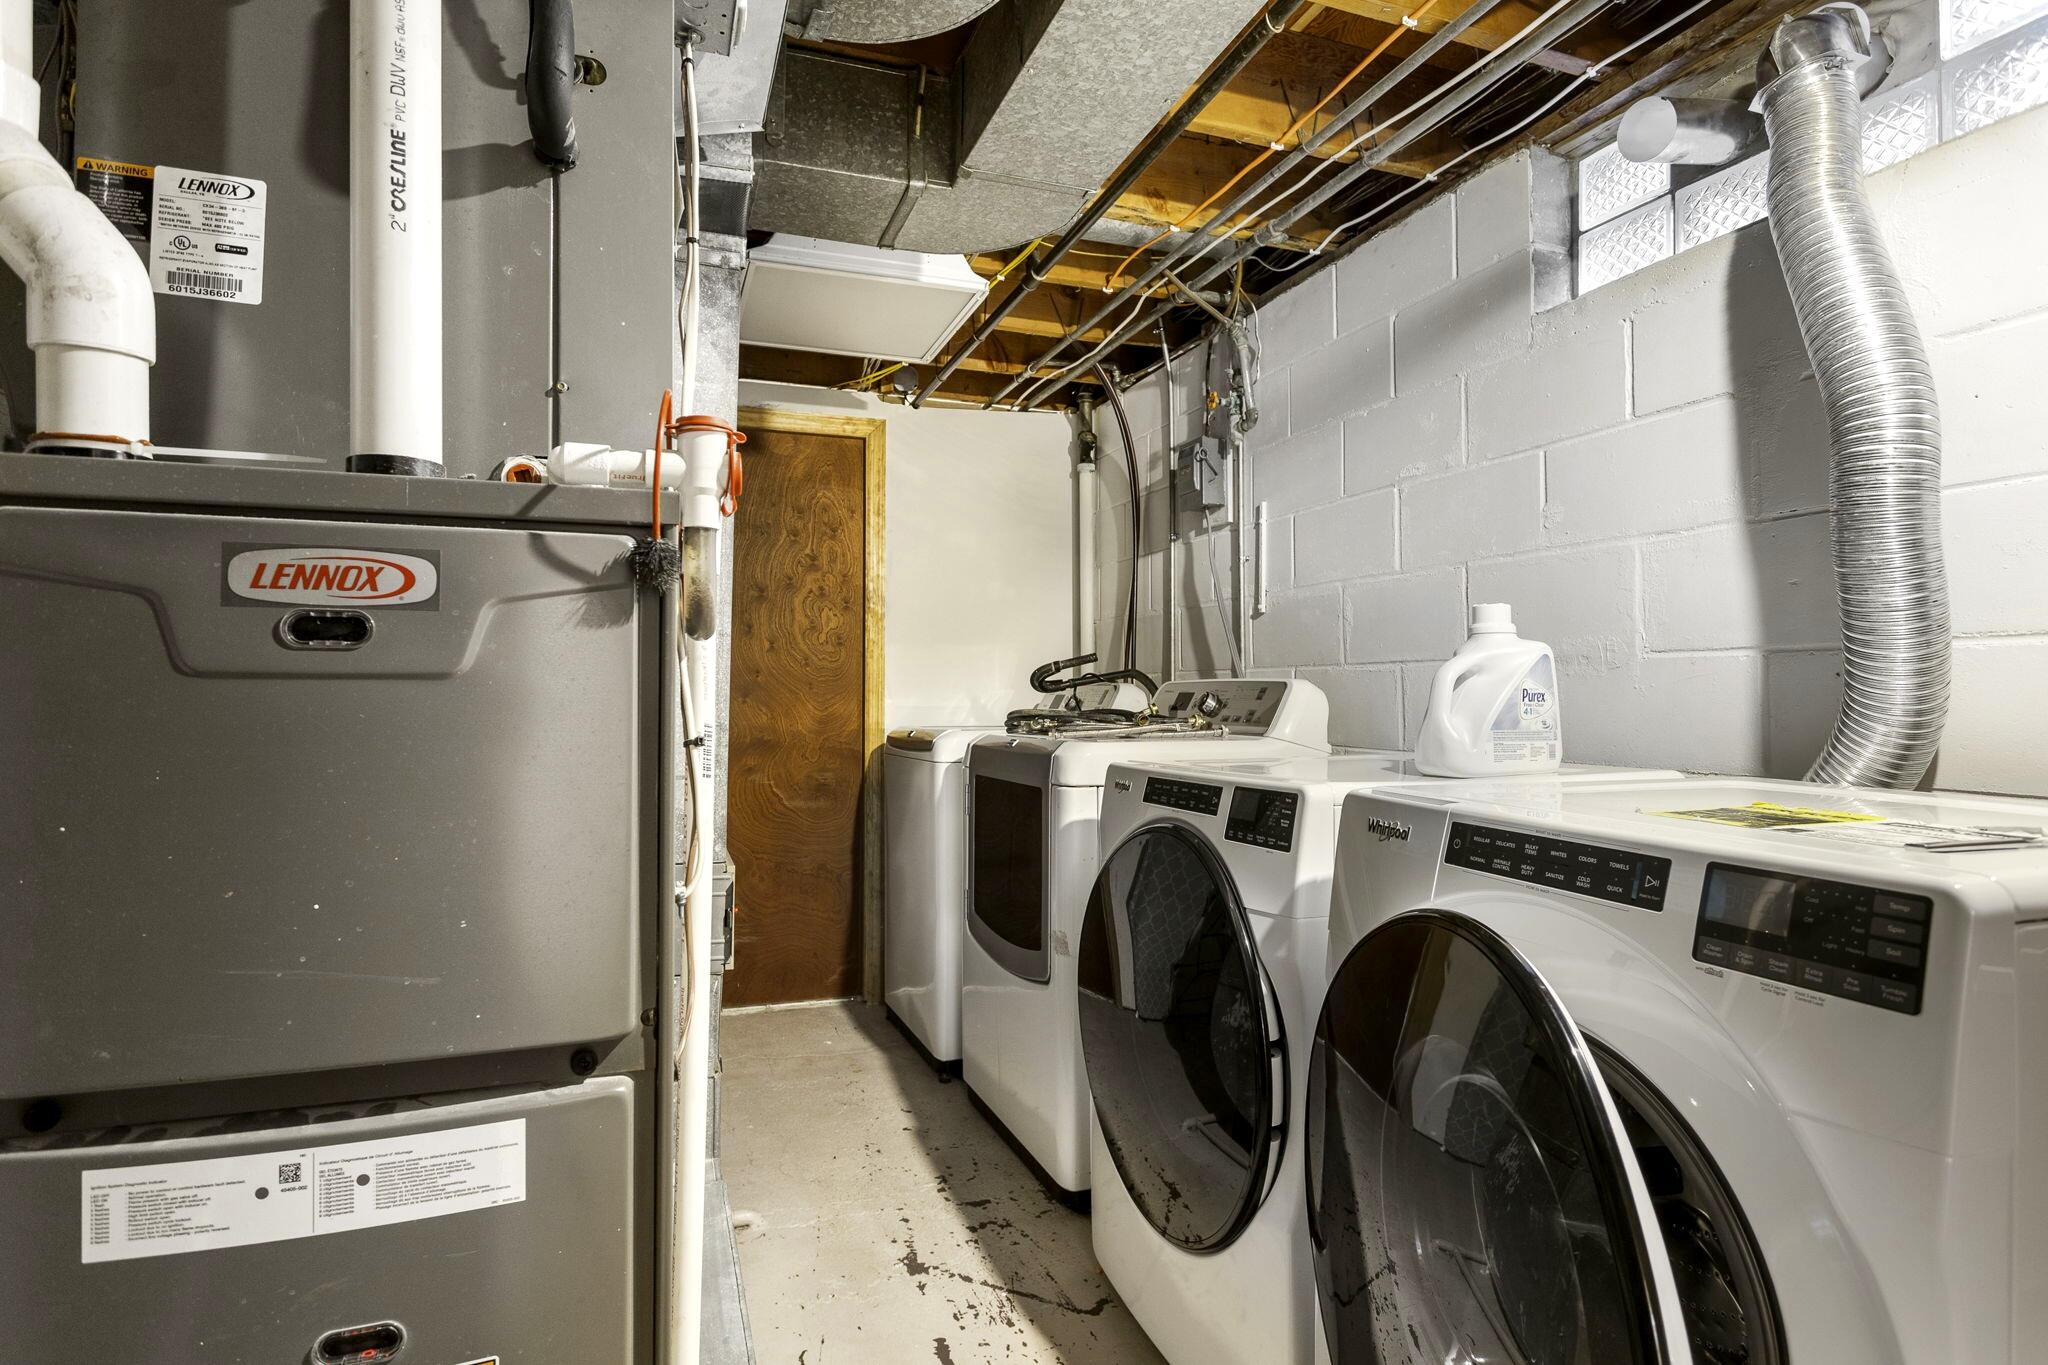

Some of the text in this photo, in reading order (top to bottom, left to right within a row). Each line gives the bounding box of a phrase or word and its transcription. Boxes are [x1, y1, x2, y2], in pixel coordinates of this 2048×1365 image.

[394, 40, 406, 62] NSF
[395, 100, 406, 122] PVC
[96, 162, 148, 176] WARNING
[390, 128, 406, 212] CRESLINE
[178, 178, 240, 196] LENNOX
[204, 269, 234, 278] NUMBER
[169, 285, 236, 299] 6015J36602
[249, 562, 385, 592] LENNOX
[1522, 688, 1545, 702] Purex
[1368, 817, 1412, 841] Whirlpool
[1496, 840, 1516, 848] DELICATES
[1578, 855, 1597, 864] COLORS
[1609, 862, 1629, 870] TOWELS
[1492, 863, 1510, 871] CONTROL
[1545, 872, 1564, 880] SANITIZE
[1607, 885, 1623, 893] QUICK
